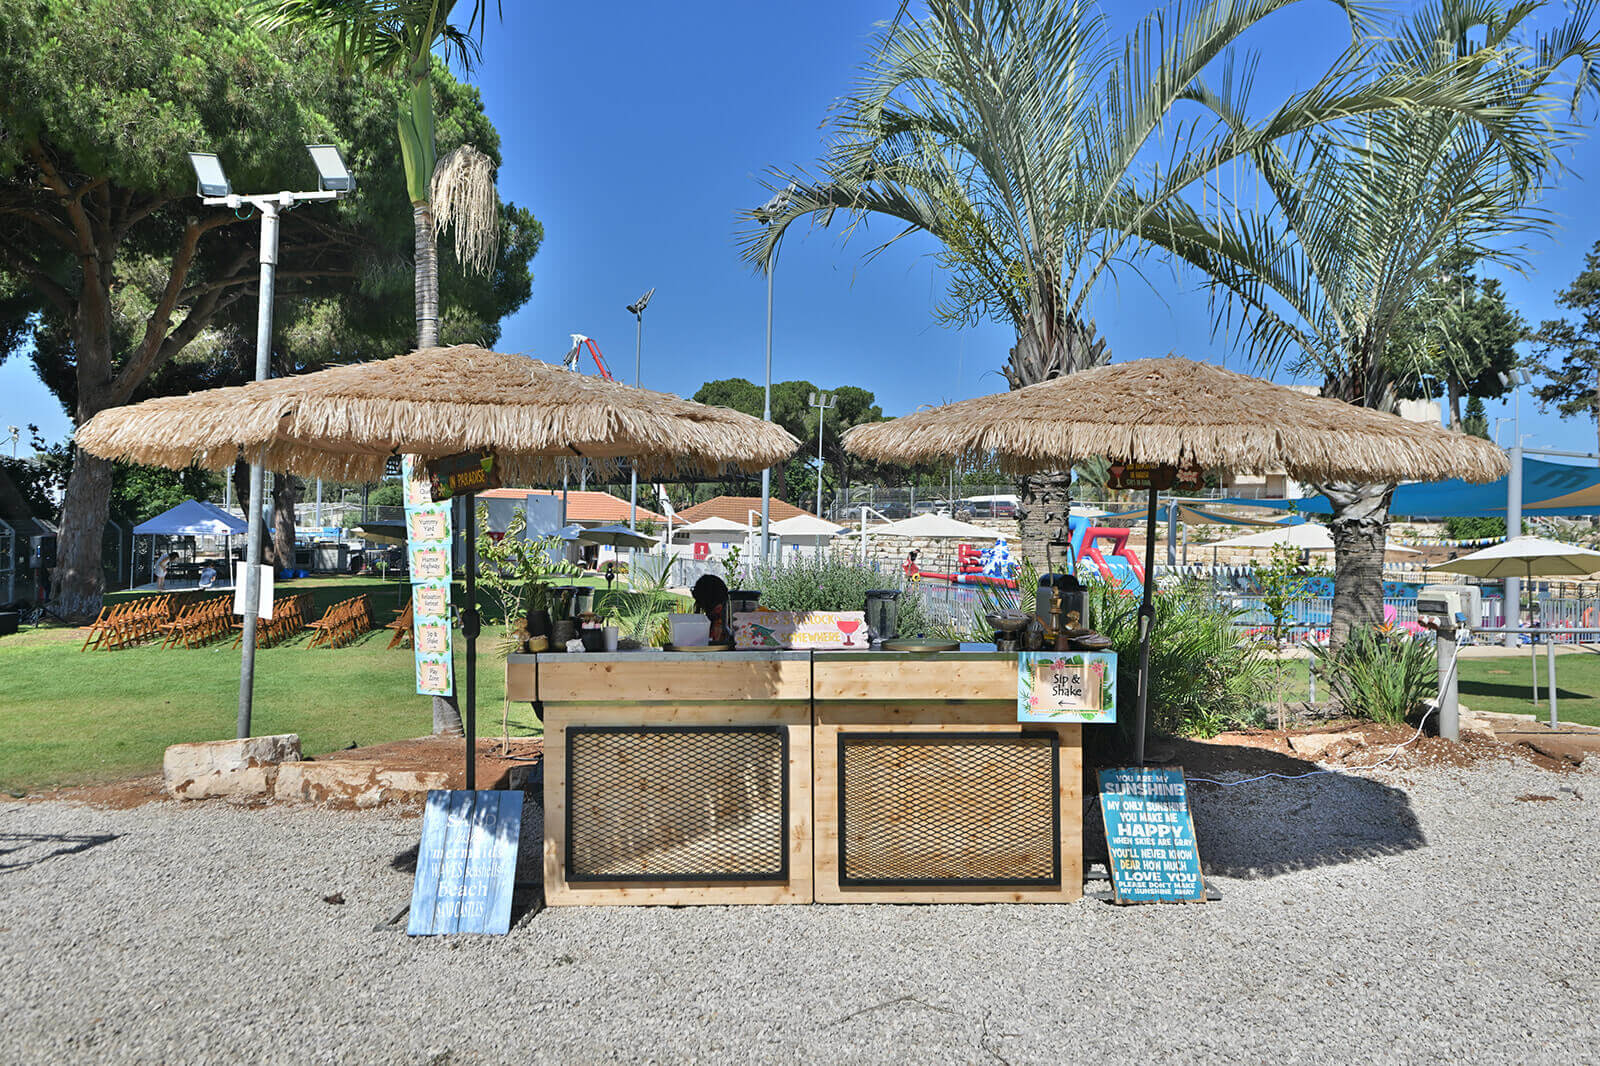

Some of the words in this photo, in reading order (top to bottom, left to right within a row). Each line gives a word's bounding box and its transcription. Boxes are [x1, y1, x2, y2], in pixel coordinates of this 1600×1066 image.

[457, 469, 486, 488] PARADISE
[781, 631, 841, 643] SOMEWHERE
[1053, 674, 1069, 687] Sip
[1072, 674, 1081, 685] &
[1052, 684, 1082, 696] Shake
[1116, 775, 1134, 783] YOU
[1136, 775, 1153, 783] ARE
[1156, 775, 1169, 783] MY
[1104, 782, 1185, 796] SUNSHINE
[1107, 800, 1120, 811] MY
[1122, 801, 1144, 811] ONLY
[1146, 801, 1187, 812] SUNSHINE
[1119, 812, 1137, 822] YOU
[1139, 812, 1163, 823] MAKE
[1165, 812, 1178, 823] ME
[1117, 823, 1184, 838] HAPPY
[1112, 837, 1133, 845] WHEN
[1134, 838, 1156, 846] SKIES
[1158, 838, 1173, 846] ARE
[431, 847, 504, 859] mermids
[1111, 848, 1140, 859] YOU'LL
[1141, 848, 1167, 860] NEVER
[1168, 849, 1193, 860] KNOW
[1119, 860, 1141, 870] DEAR
[1142, 860, 1162, 871] HOW
[1163, 860, 1187, 872] MUCH
[1115, 871, 1120, 881] I
[1124, 871, 1162, 882] LOVE
[1167, 872, 1197, 883] YOU
[438, 880, 487, 897] beach
